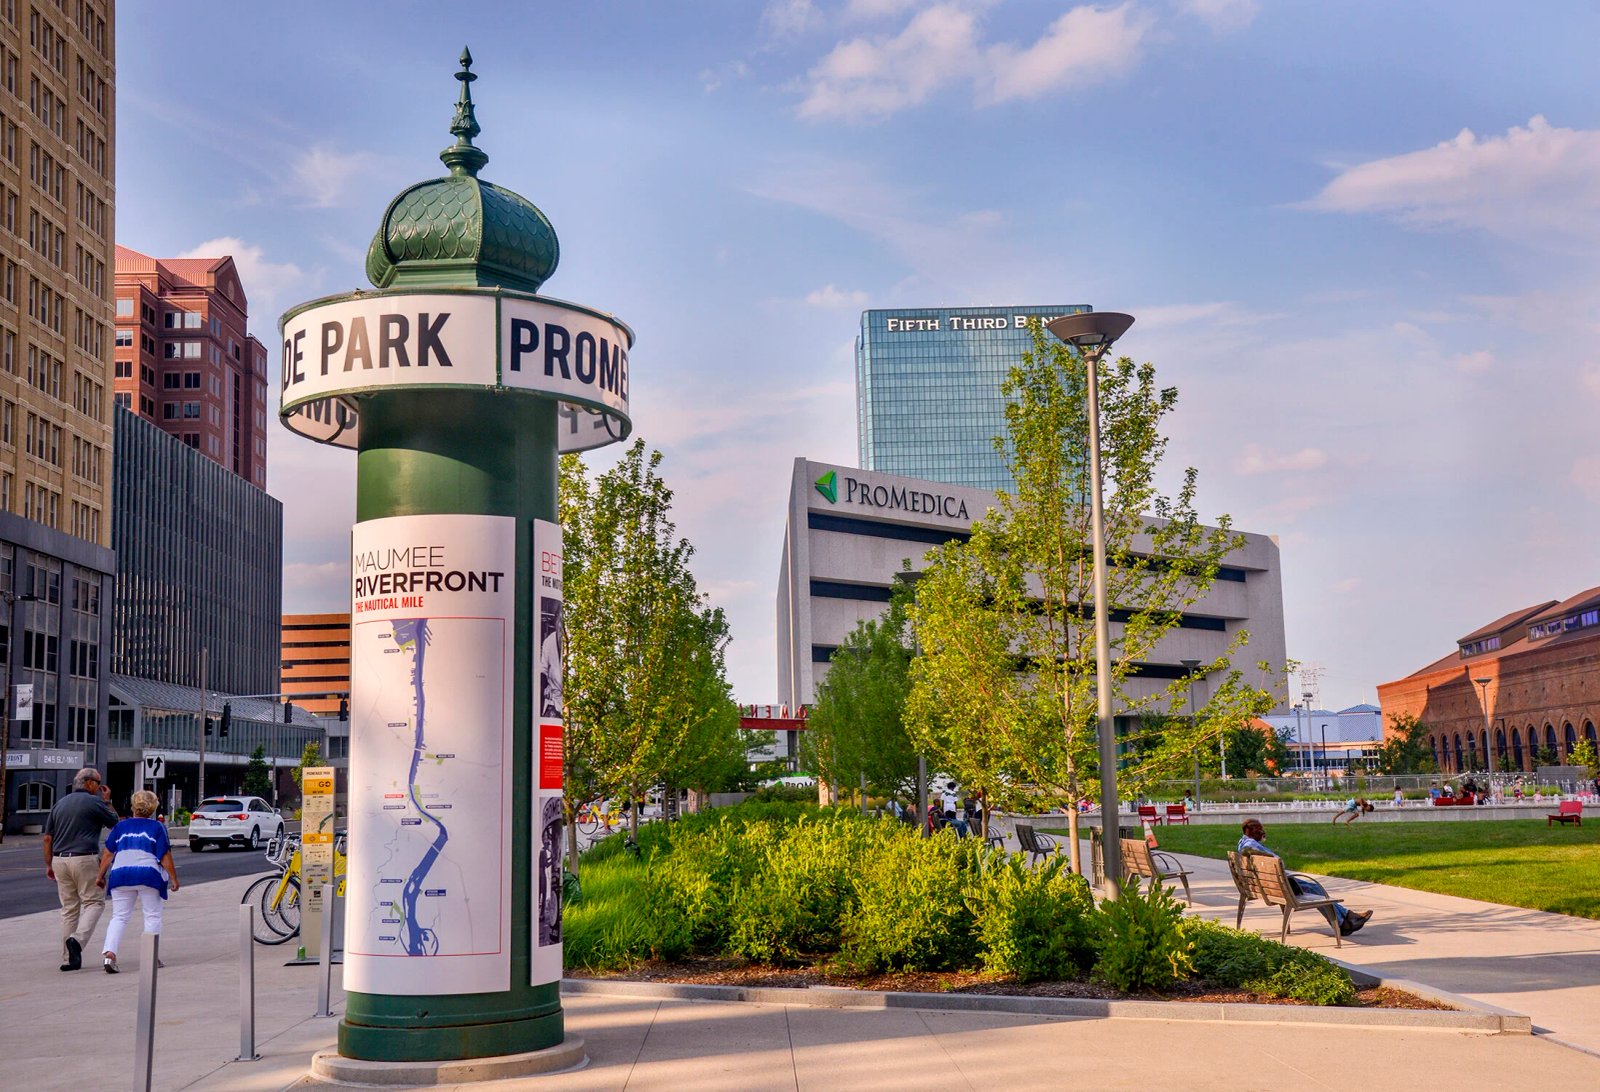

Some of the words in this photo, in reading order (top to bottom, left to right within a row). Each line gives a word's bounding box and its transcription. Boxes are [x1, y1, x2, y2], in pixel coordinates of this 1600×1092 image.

[887, 318, 940, 332] FIFTH
[950, 316, 1008, 331] THIRD
[321, 313, 453, 376] PARK
[355, 546, 445, 574] MAUMEE
[355, 571, 504, 598] RIVERFRONT
[355, 601, 364, 614] THE
[364, 597, 398, 612] NAUTICAL
[401, 596, 424, 609] MILE
